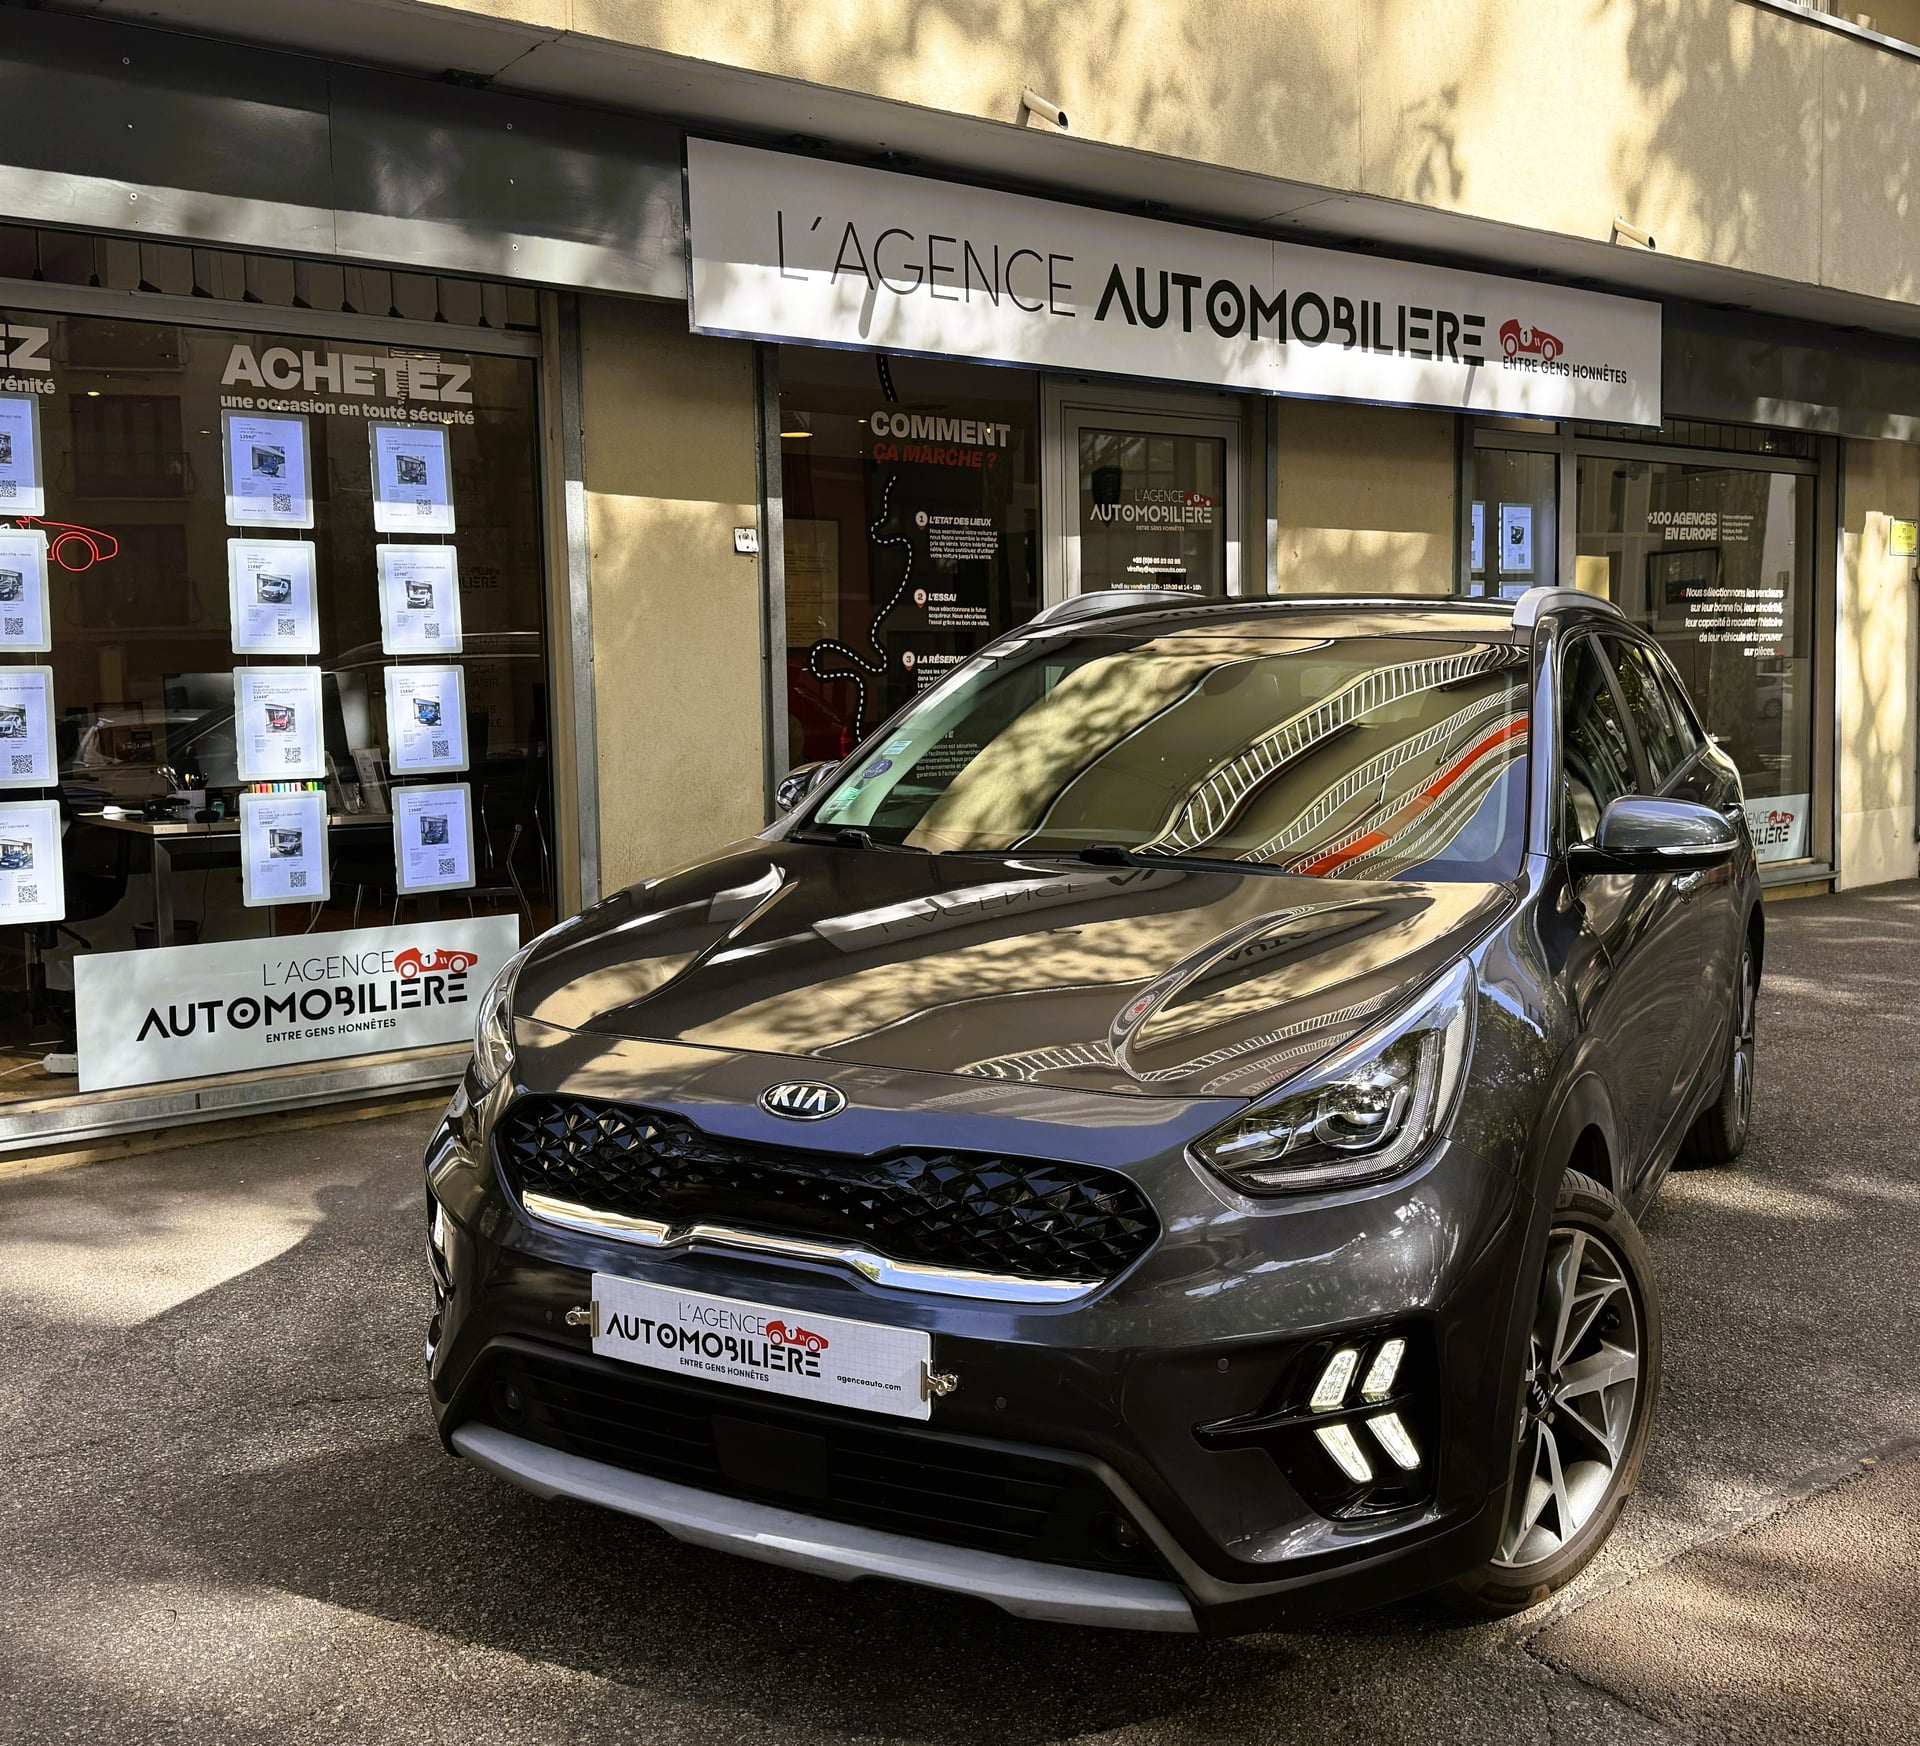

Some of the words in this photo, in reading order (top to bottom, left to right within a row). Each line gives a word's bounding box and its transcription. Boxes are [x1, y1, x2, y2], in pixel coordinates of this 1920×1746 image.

[778, 211, 1075, 317] L'AGENCE
[220, 345, 473, 404] ACHETEZ
[1503, 356, 1538, 373] ENTRE
[1541, 361, 1569, 376] GENS
[1573, 364, 1627, 384] HONNÊTES
[220, 395, 253, 408] une
[257, 396, 336, 415] occasion
[339, 402, 360, 416] en
[362, 403, 407, 420] toute
[410, 407, 475, 425] sécurité
[871, 410, 1010, 447] COMMENT
[873, 443, 899, 464] ÇA
[903, 446, 982, 468] MARCHE
[1135, 489, 1184, 503] L'AGENCE
[953, 517, 969, 525] DES
[970, 518, 992, 526] LIEUX
[1648, 512, 1671, 525] +100
[1672, 512, 1717, 525] AGENCES
[1665, 528, 1679, 540] EN
[1679, 528, 1717, 540] EUROPE
[928, 593, 957, 602] L'ESSAI
[1686, 588, 1703, 597] Nous
[1703, 588, 1745, 597] sélectionnons
[1746, 588, 1755, 597] les
[1756, 588, 1783, 598] vendeurs
[1690, 604, 1701, 612] sur
[1702, 603, 1714, 612] leur
[1714, 603, 1733, 612] bonne
[1744, 603, 1755, 612] leur
[1685, 618, 1698, 627] leur
[1698, 617, 1726, 628] capacité
[1731, 618, 1757, 627] raconter
[1699, 633, 1707, 642] de
[1708, 633, 1720, 642] leur
[1721, 632, 1746, 642] véhicule
[1746, 633, 1752, 642] et
[1759, 633, 1783, 643] prouver
[1744, 648, 1754, 656] sur
[1754, 646, 1775, 658] pièces.
[262, 951, 394, 987] L'AGENCE
[266, 1030, 302, 1043] ENTRE
[305, 1025, 335, 1038] GENS
[338, 1018, 396, 1035] HONNÊTES
[772, 1086, 828, 1110] KIA
[679, 1302, 766, 1336] L'AGENCE
[680, 1357, 703, 1369] ENTRE
[705, 1361, 726, 1373] GENS
[727, 1366, 769, 1382] HONNÊTES
[836, 1374, 902, 1391] agenceauto.com
[1532, 1380, 1547, 1408] KIA
